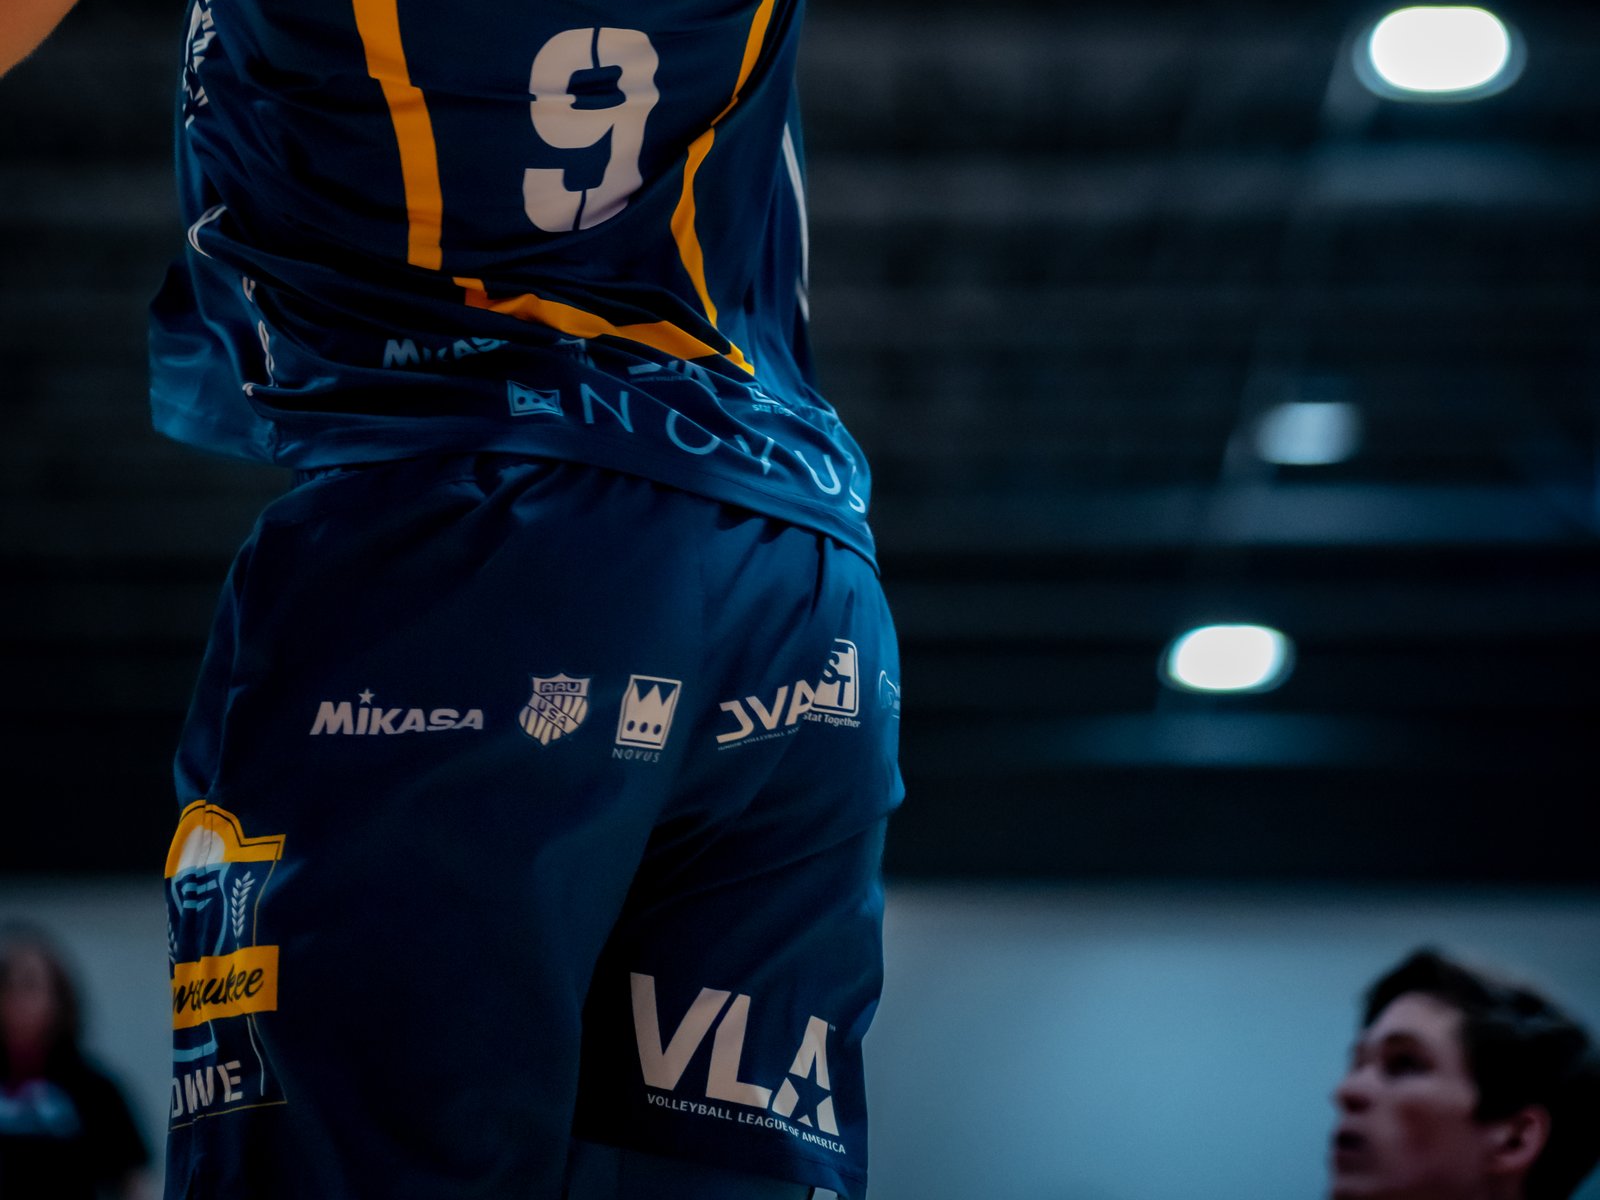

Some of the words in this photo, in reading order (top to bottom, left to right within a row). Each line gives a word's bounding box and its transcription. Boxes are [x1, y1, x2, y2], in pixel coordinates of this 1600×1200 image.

[522, 27, 660, 232] 9
[541, 682, 581, 693] AAU
[537, 700, 568, 729] USA
[716, 680, 816, 744] JVA
[824, 713, 861, 729] Together
[612, 747, 661, 763] NOVUS
[630, 972, 840, 1137] VLA
[648, 1093, 733, 1121] VOLLEYBALL
[738, 1111, 788, 1132] LEAGUE
[788, 1125, 799, 1137] OF
[802, 1131, 846, 1154] AMERICA
